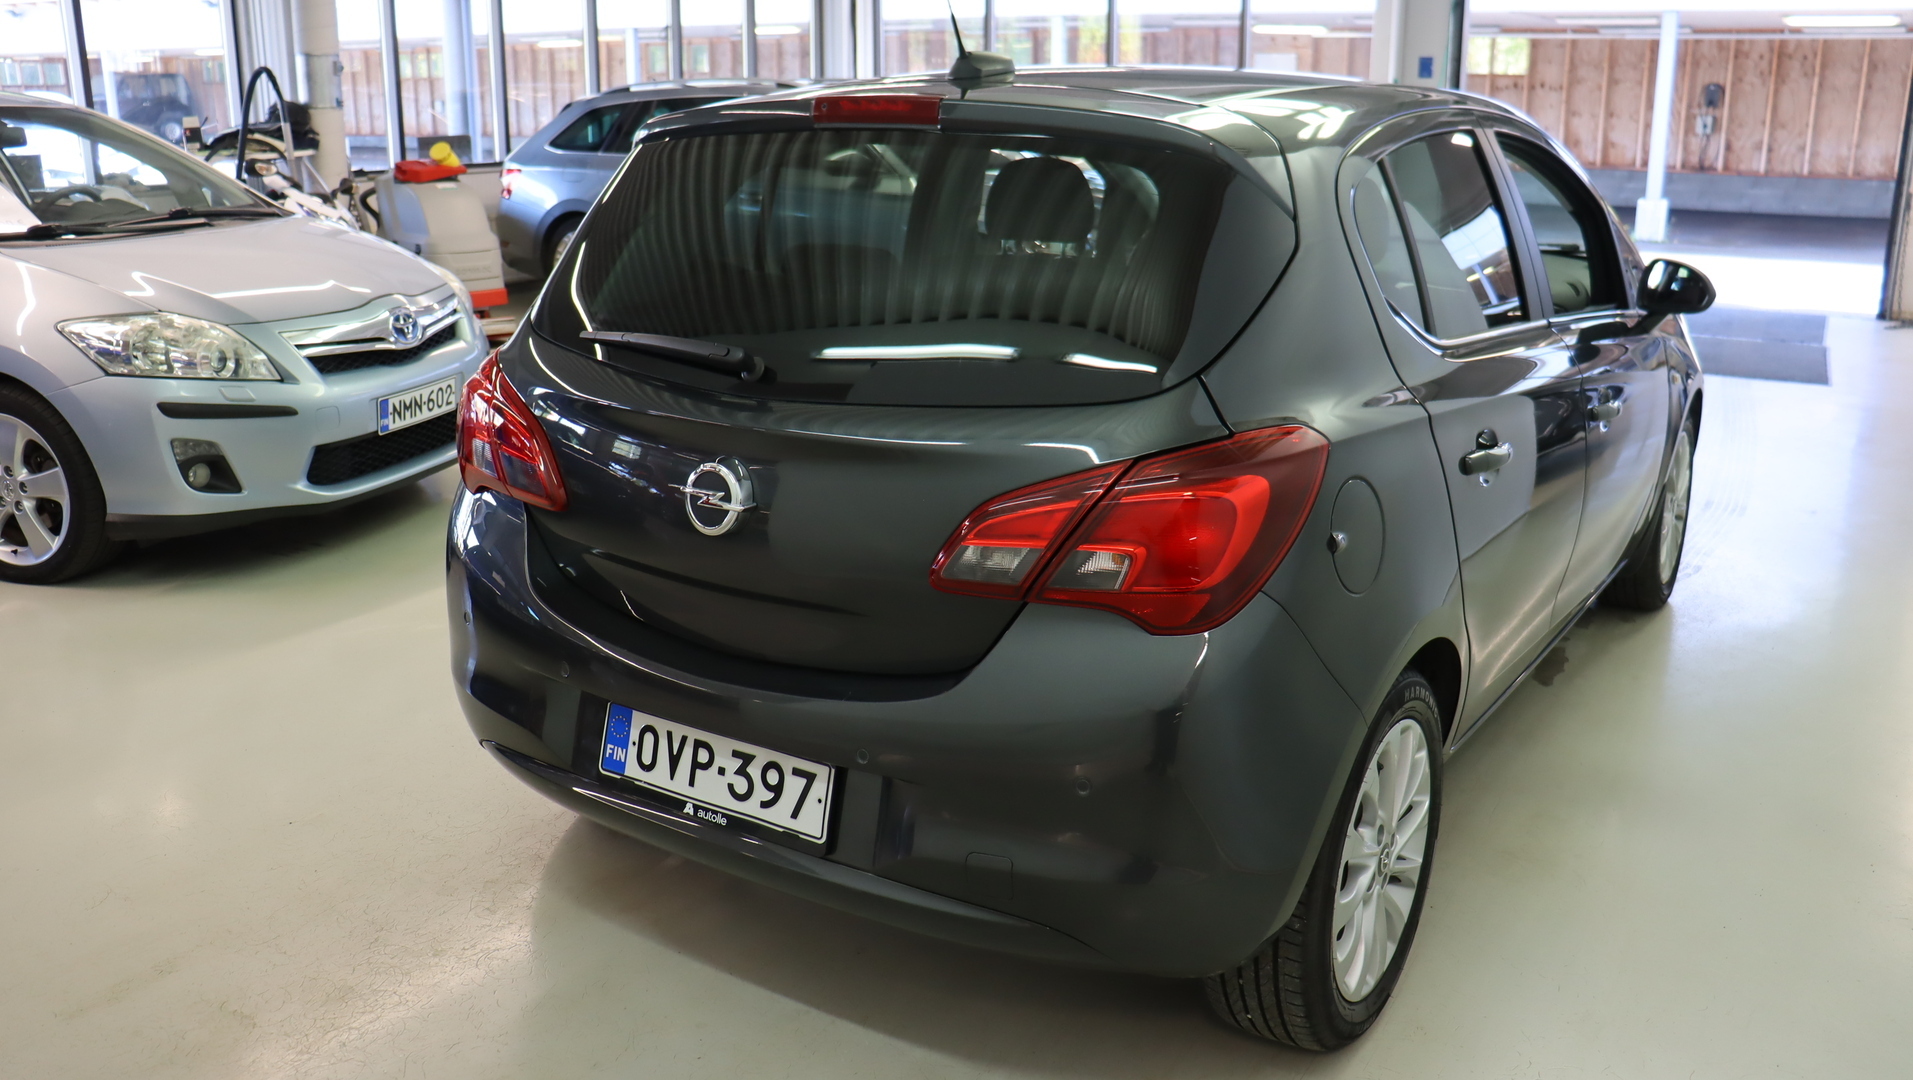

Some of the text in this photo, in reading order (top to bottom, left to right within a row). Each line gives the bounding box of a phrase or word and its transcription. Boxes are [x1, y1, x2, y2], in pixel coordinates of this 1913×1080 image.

[392, 384, 453, 424] NMN-602
[605, 724, 817, 819] FIN OVP-397
[697, 809, 728, 826] autolle
